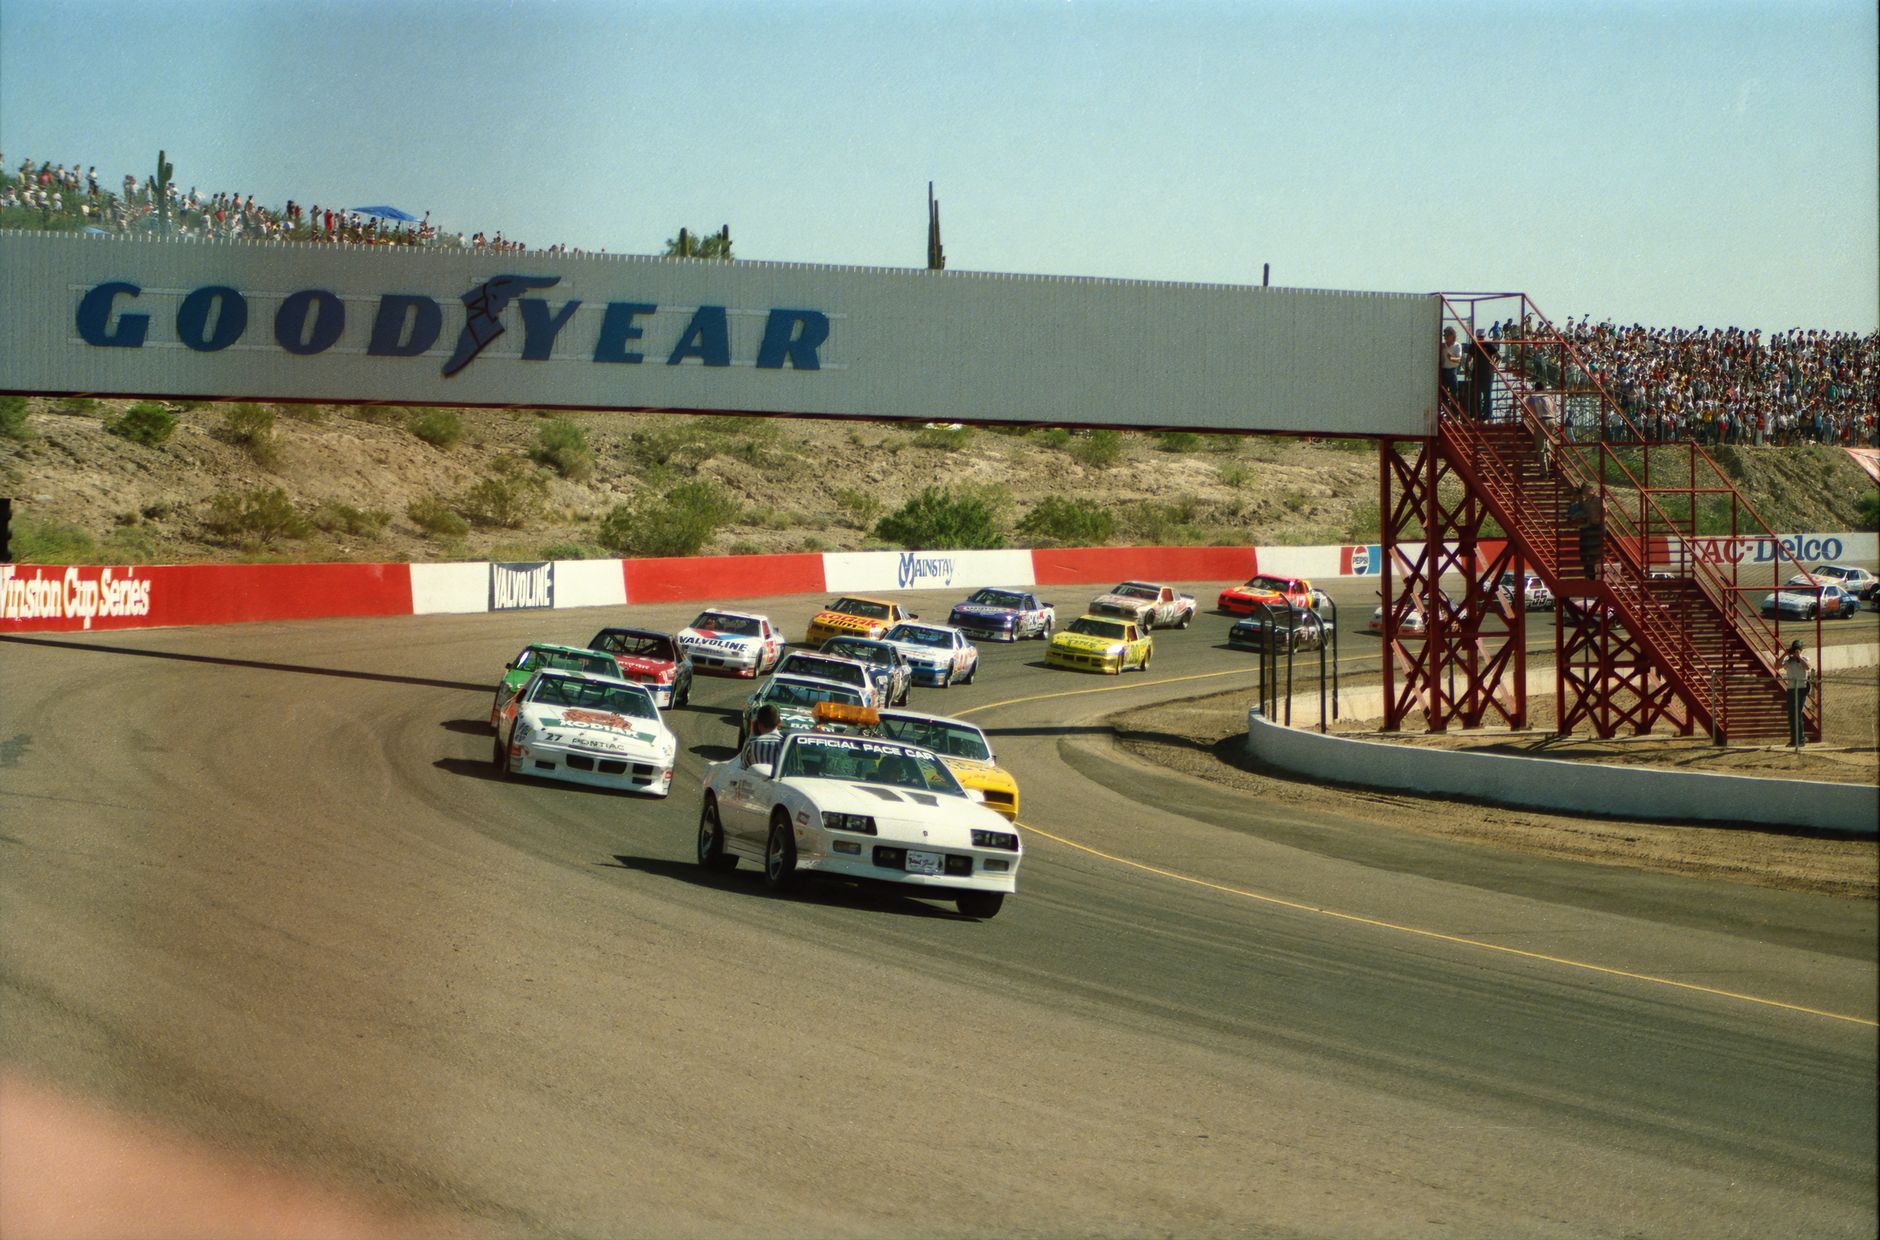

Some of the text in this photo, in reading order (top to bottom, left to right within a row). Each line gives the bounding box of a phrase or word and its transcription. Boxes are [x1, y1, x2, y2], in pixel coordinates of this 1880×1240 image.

[74, 279, 832, 371] GOODYEAR
[1702, 535, 1843, 563] AC-Delco
[0, 565, 150, 630] Winston Cup Series
[493, 562, 552, 609] VALVOLINE
[679, 635, 749, 652] VALVOLINE
[545, 732, 563, 742] 27
[559, 719, 639, 739] KODIAK
[572, 737, 625, 751] PONTIAC
[796, 737, 936, 762] OFFICIAL PACE CAR
